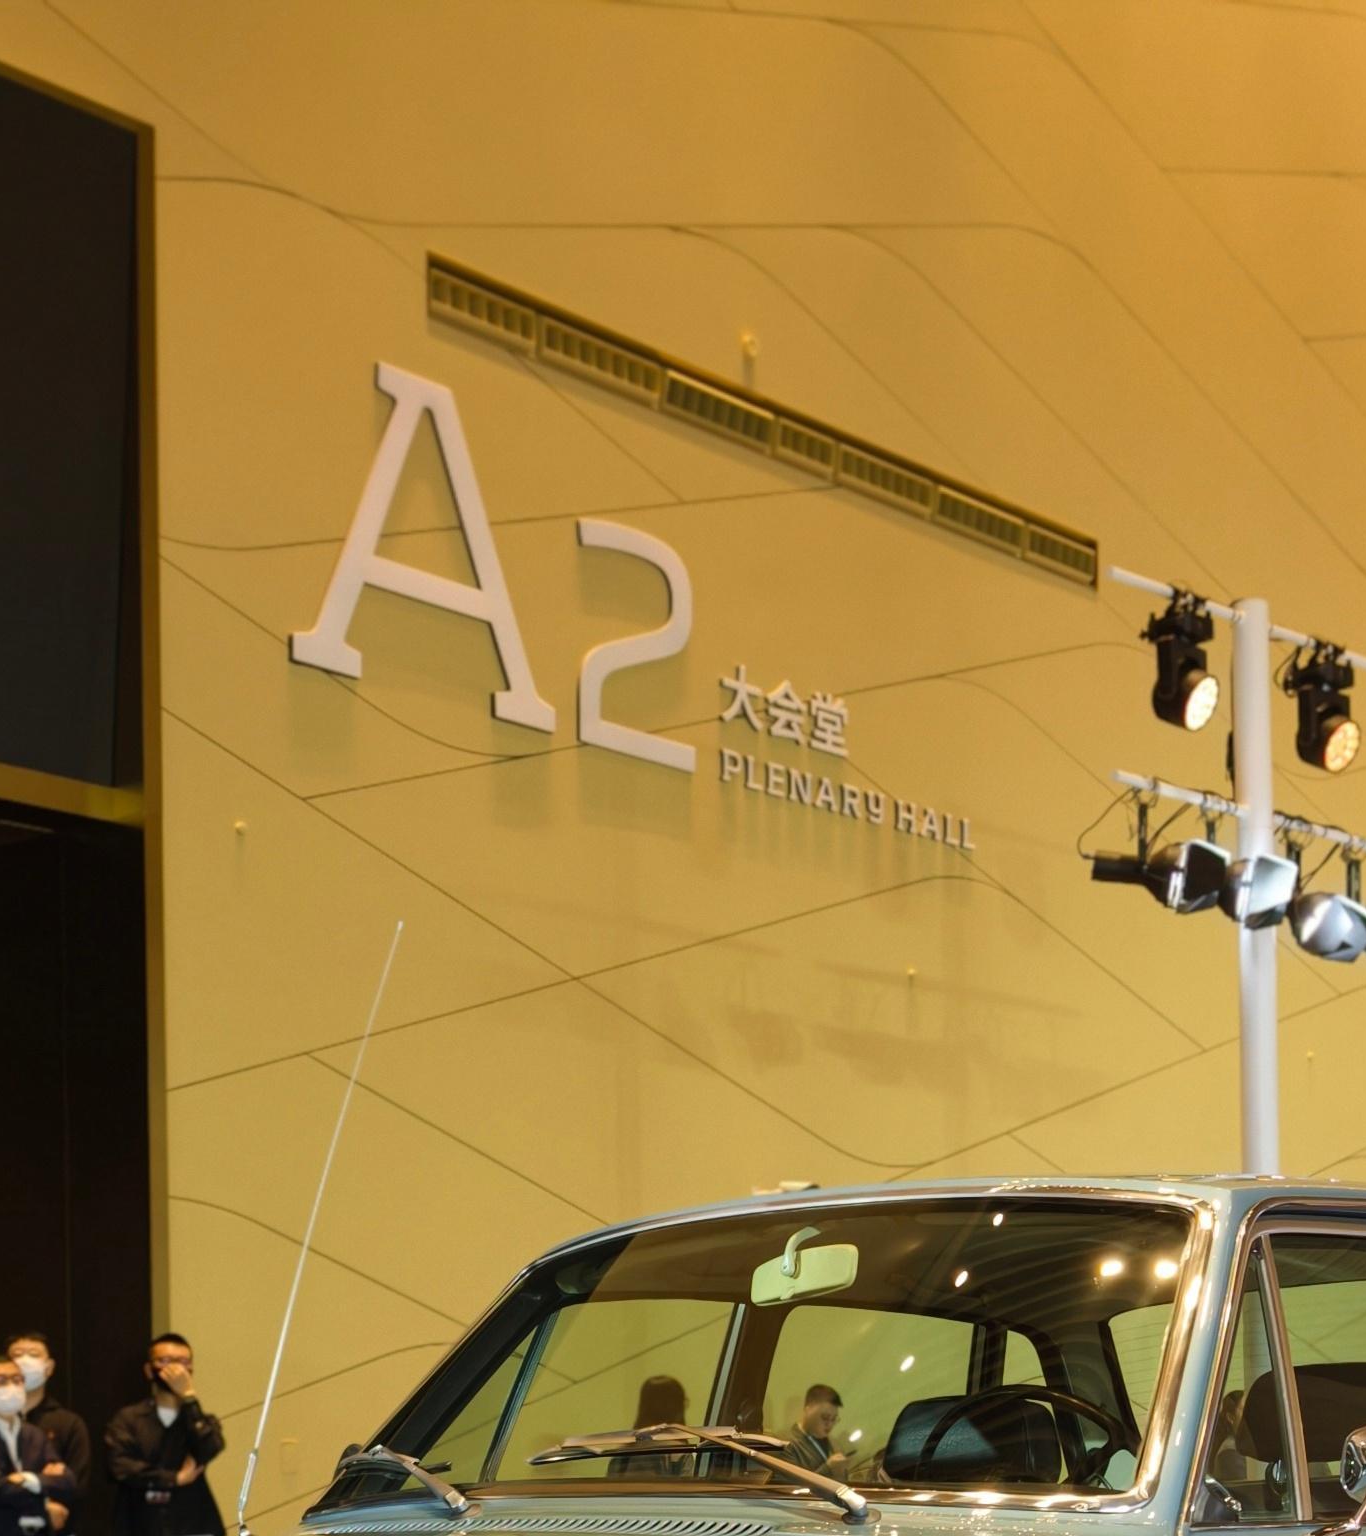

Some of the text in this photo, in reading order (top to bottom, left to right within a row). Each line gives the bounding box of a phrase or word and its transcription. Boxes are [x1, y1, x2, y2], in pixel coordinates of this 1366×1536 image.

[289, 361, 696, 772] A2
[720, 664, 849, 758] 大会堂
[894, 800, 976, 850] HALL
